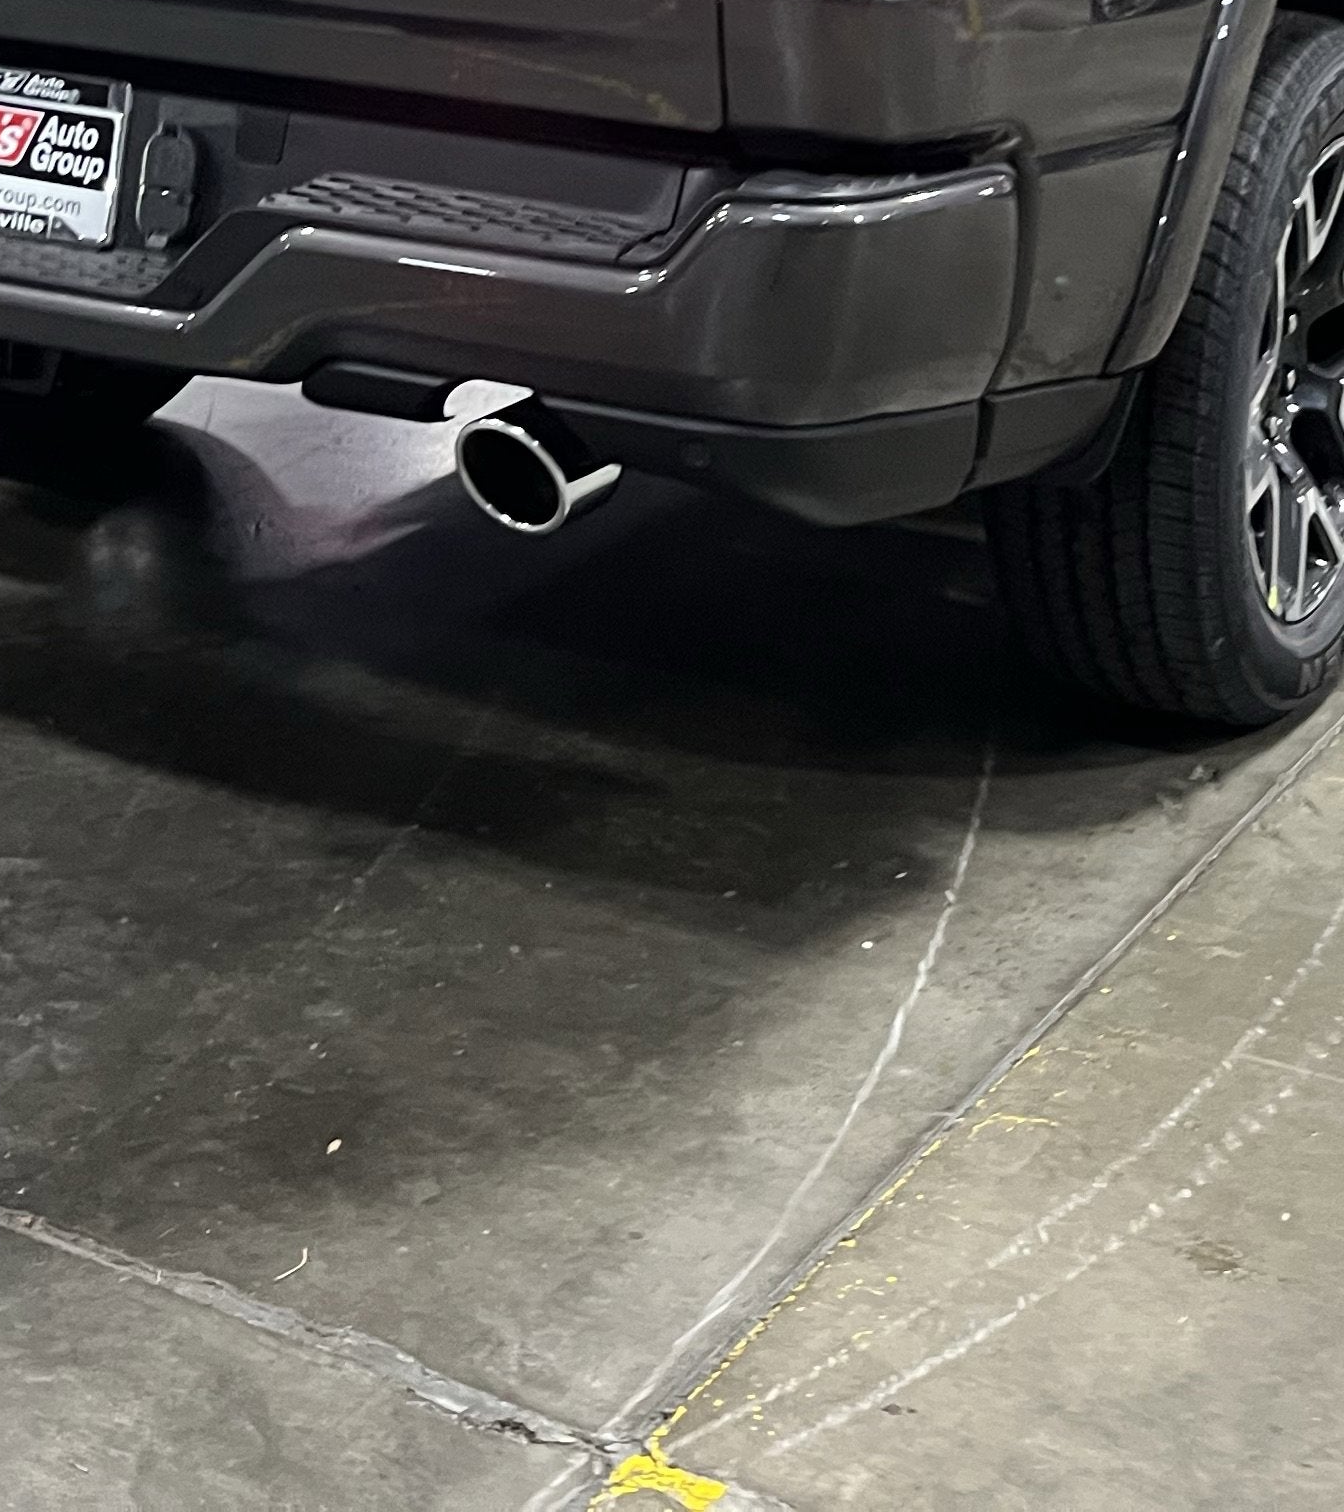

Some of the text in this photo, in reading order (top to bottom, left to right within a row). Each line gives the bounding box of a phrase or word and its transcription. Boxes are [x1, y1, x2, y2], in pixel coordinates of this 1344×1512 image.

[29, 74, 65, 90] Auto
[38, 115, 100, 151] Auto
[30, 142, 105, 185] Group
